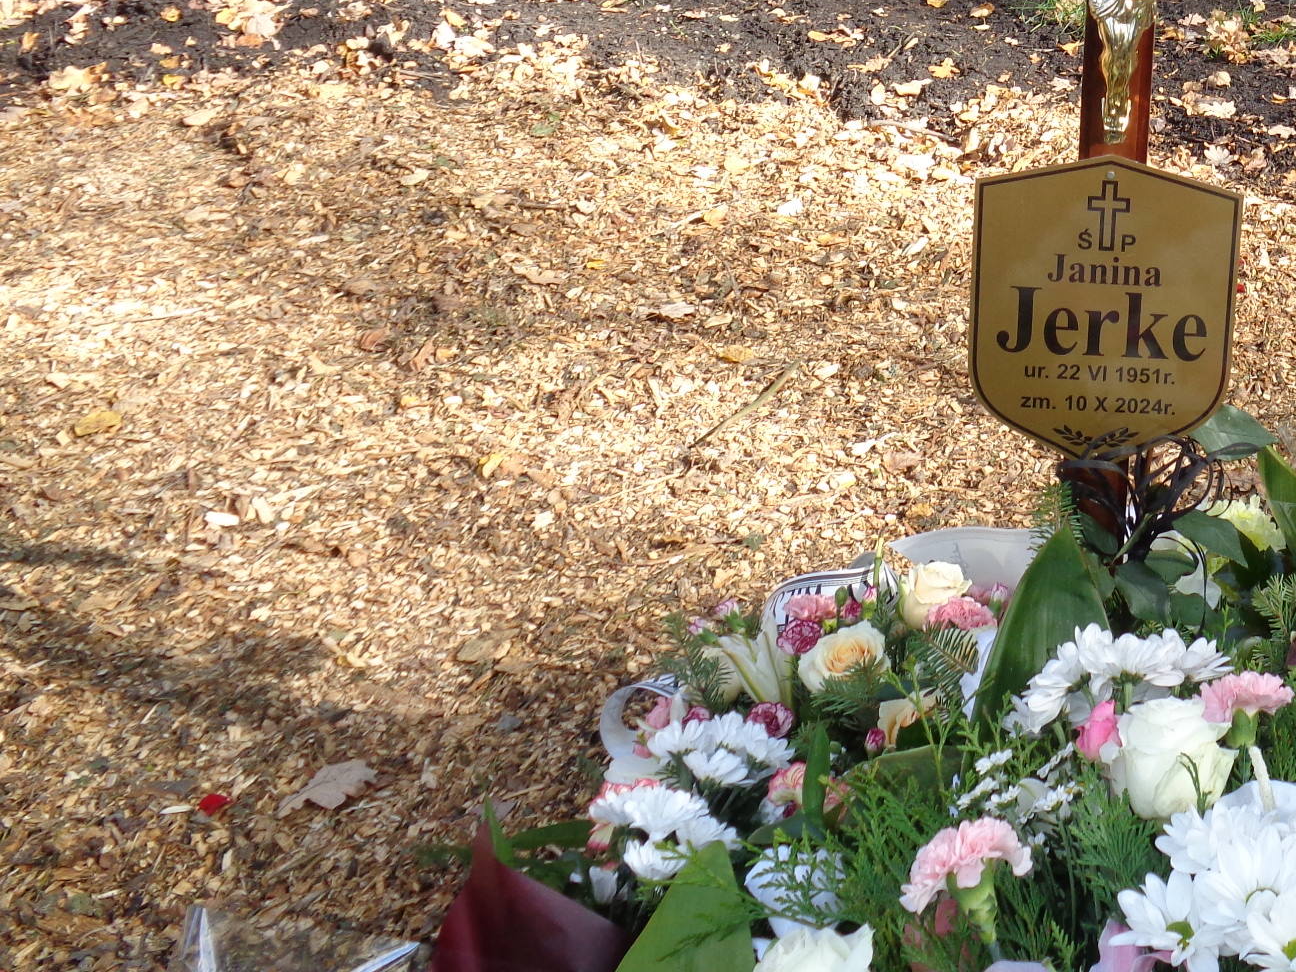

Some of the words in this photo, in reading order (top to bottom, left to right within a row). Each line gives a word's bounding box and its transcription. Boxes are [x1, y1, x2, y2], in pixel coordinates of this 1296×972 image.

[1077, 228, 1093, 251] Ś
[1121, 234, 1137, 253] P
[1047, 253, 1162, 288] Janina
[996, 285, 1208, 363] Jerke
[1024, 365, 1049, 379] ur.
[1057, 363, 1081, 381] 22
[1087, 364, 1108, 382] VI
[1115, 366, 1176, 385] 1951r.
[1020, 395, 1057, 410] zm.
[1064, 394, 1088, 412] 10
[1093, 396, 1108, 413] X
[1114, 397, 1176, 416] 2024r.
